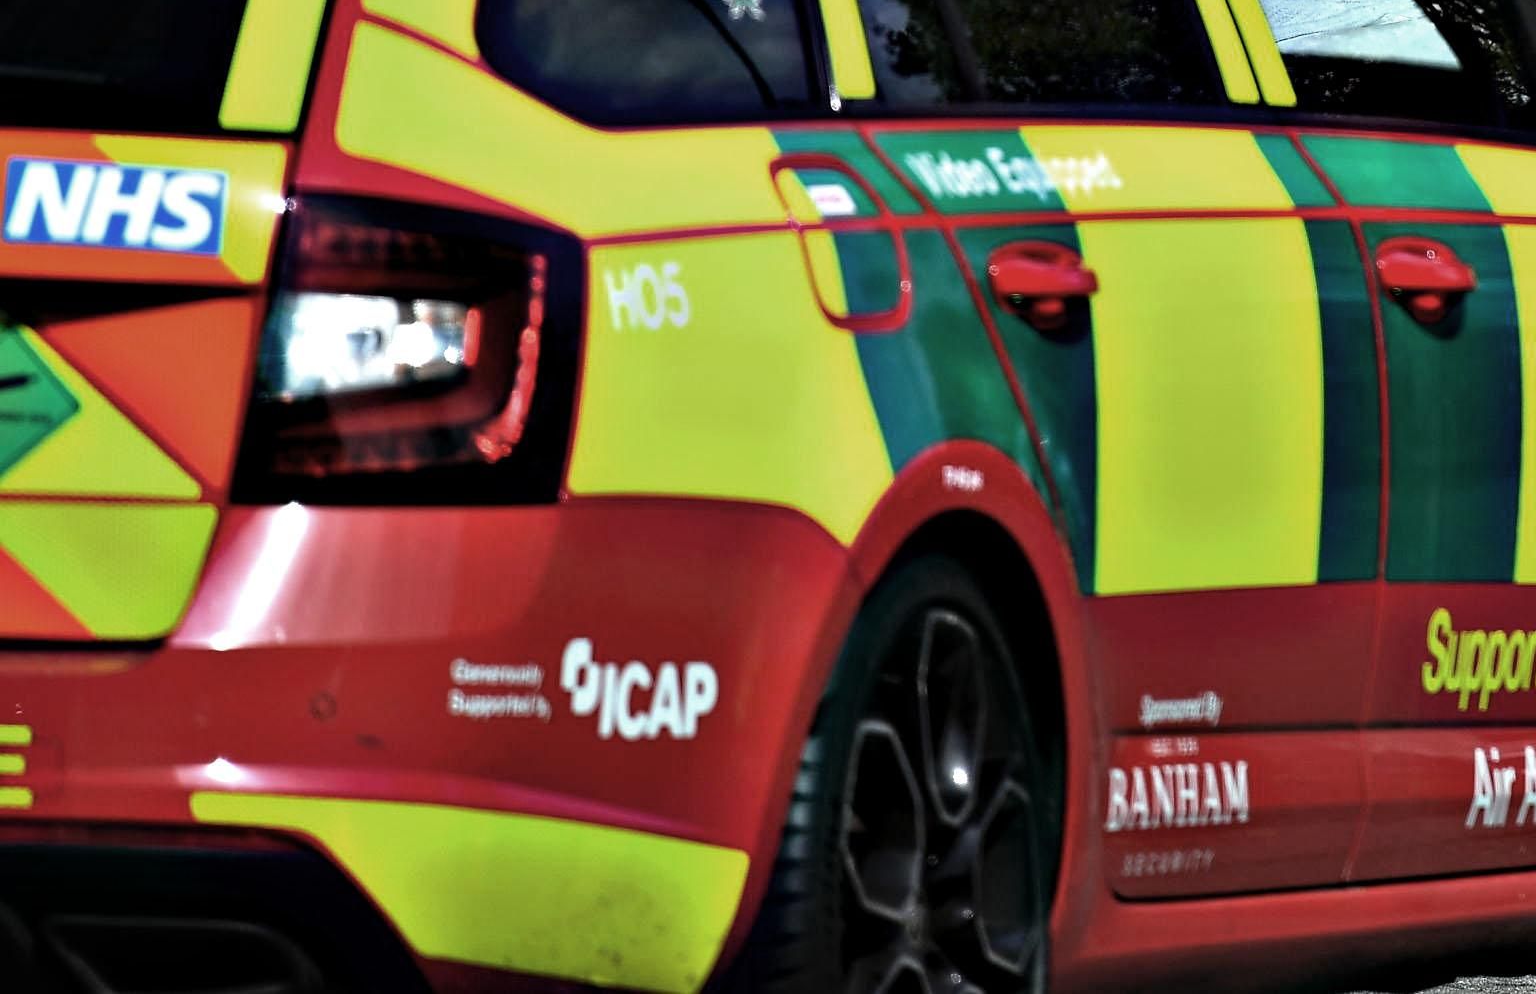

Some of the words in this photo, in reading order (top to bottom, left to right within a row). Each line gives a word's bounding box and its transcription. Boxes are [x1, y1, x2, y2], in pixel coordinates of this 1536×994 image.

[5, 161, 221, 250] NHS
[904, 150, 999, 197] Video
[597, 661, 719, 741] ICAP
[1104, 760, 1249, 833] BANHAM
[1464, 745, 1517, 830] Air
